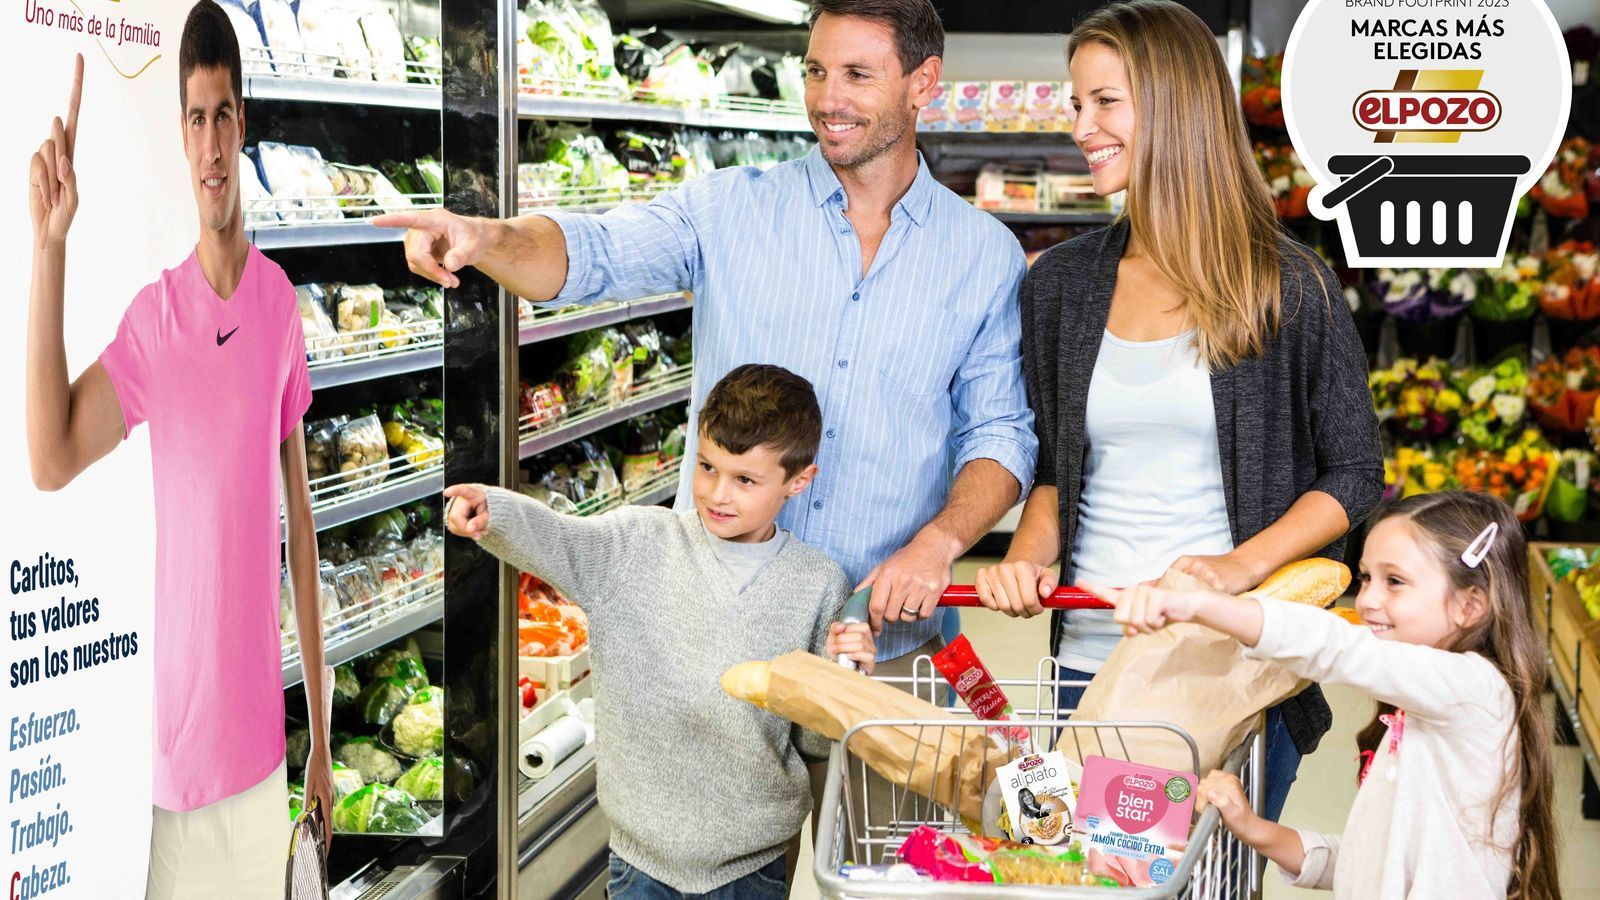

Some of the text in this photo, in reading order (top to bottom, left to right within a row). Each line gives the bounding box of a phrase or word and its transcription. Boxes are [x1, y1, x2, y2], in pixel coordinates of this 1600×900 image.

[25, 0, 161, 47] Uno más de la familia
[10, 552, 79, 595] Carlitos,
[10, 596, 99, 641] tus valores
[10, 631, 138, 688] son los nuestros
[9, 707, 80, 752] Esfuerzo.
[9, 754, 66, 803] Pasión.
[1118, 790, 1154, 811] bien
[10, 802, 73, 854] Trabajo.
[1116, 805, 1150, 822] star
[1091, 833, 1165, 856] JAMÓN COCIDO EXTRA
[10, 860, 70, 900] Cabeza.
[1153, 865, 1170, 877] SAL
